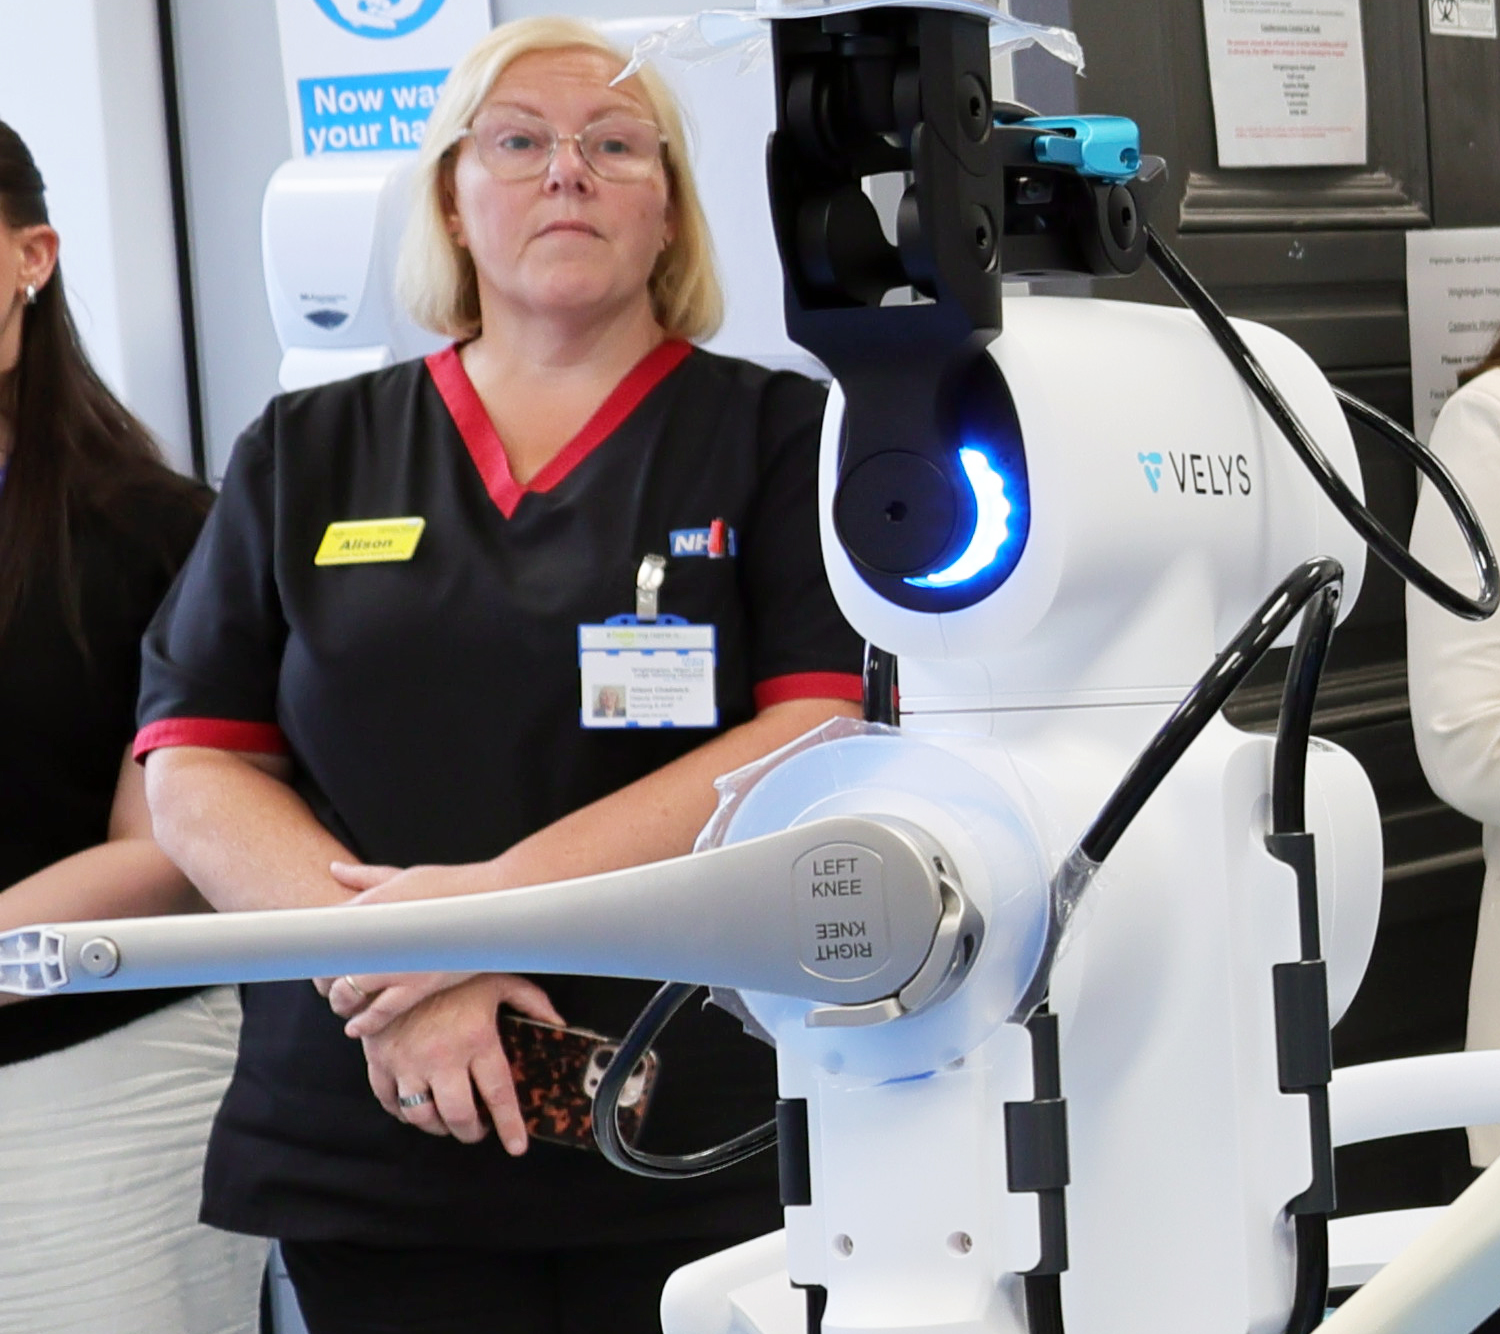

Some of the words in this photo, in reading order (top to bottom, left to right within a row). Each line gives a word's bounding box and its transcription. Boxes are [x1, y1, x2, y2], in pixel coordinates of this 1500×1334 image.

[314, 85, 384, 115] Now
[391, 84, 444, 110] wa
[308, 123, 382, 155] your
[1168, 451, 1252, 496] VELYS
[341, 538, 393, 551] Alison
[674, 532, 730, 554] NH
[812, 858, 859, 877] LEFT
[811, 879, 862, 898] KNEE
[815, 921, 866, 940] KNEE
[815, 942, 873, 961] RIGHT
